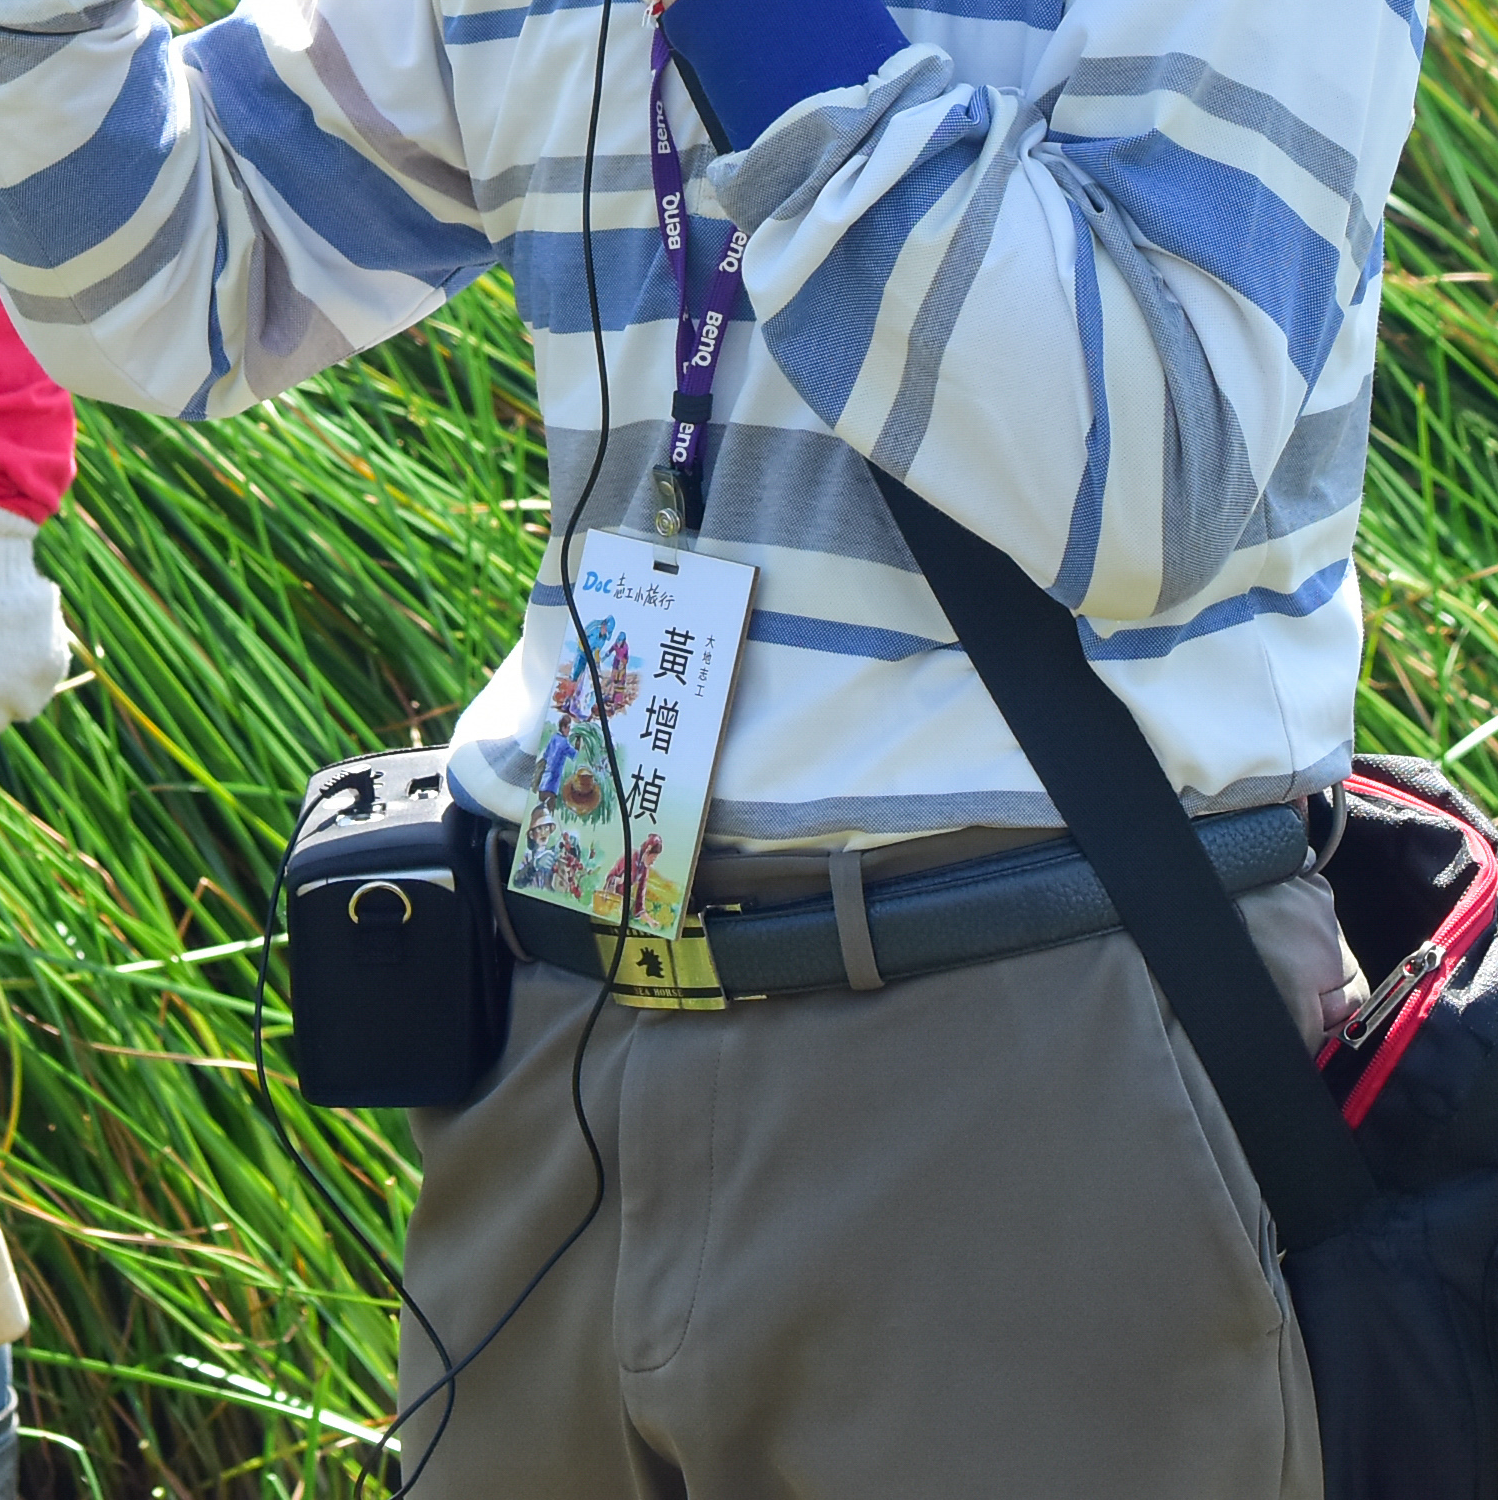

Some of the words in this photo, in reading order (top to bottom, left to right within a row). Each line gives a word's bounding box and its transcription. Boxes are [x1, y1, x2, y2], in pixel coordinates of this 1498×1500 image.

[662, 191, 681, 250] BenQ
[719, 231, 748, 273] enQ
[691, 310, 723, 367] BenQ
[672, 422, 695, 463] enQ
[695, 634, 716, 698] 大地志工
[625, 626, 696, 825] 黃增楨
[653, 988, 684, 998] HORSE
